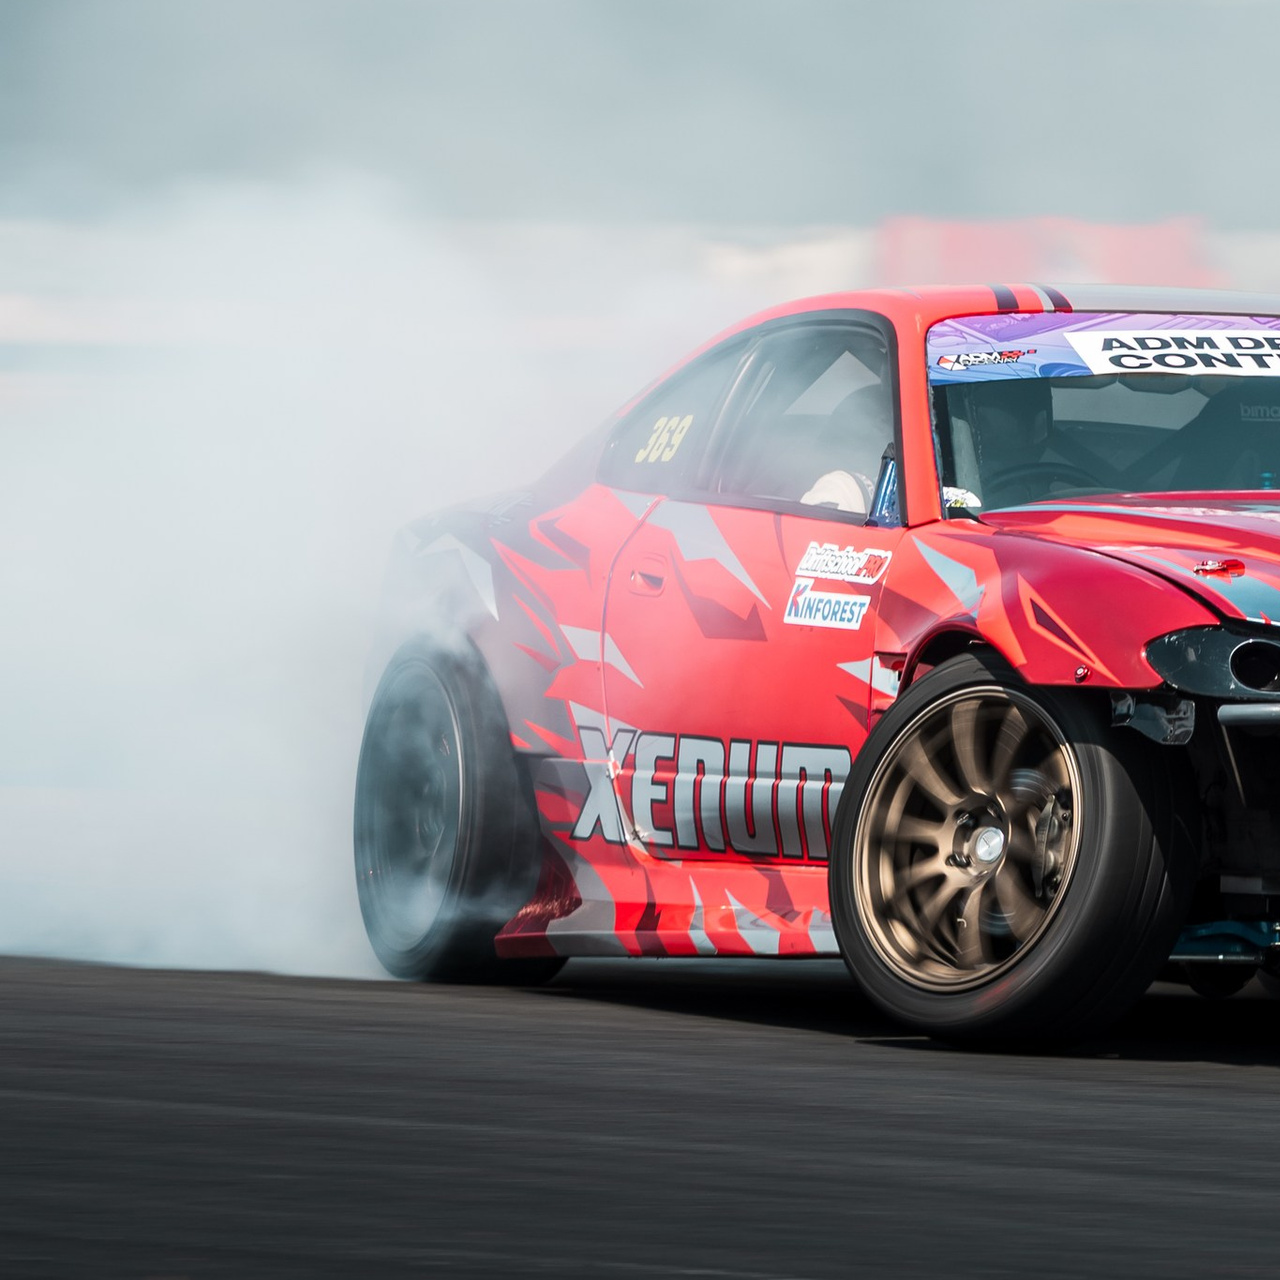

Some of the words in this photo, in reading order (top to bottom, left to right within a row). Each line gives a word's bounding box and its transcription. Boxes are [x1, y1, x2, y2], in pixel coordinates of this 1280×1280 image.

[1101, 336, 1213, 351] ADM
[634, 415, 694, 463] 369
[787, 583, 866, 624] KINFOREST
[571, 727, 852, 862] XENUM
